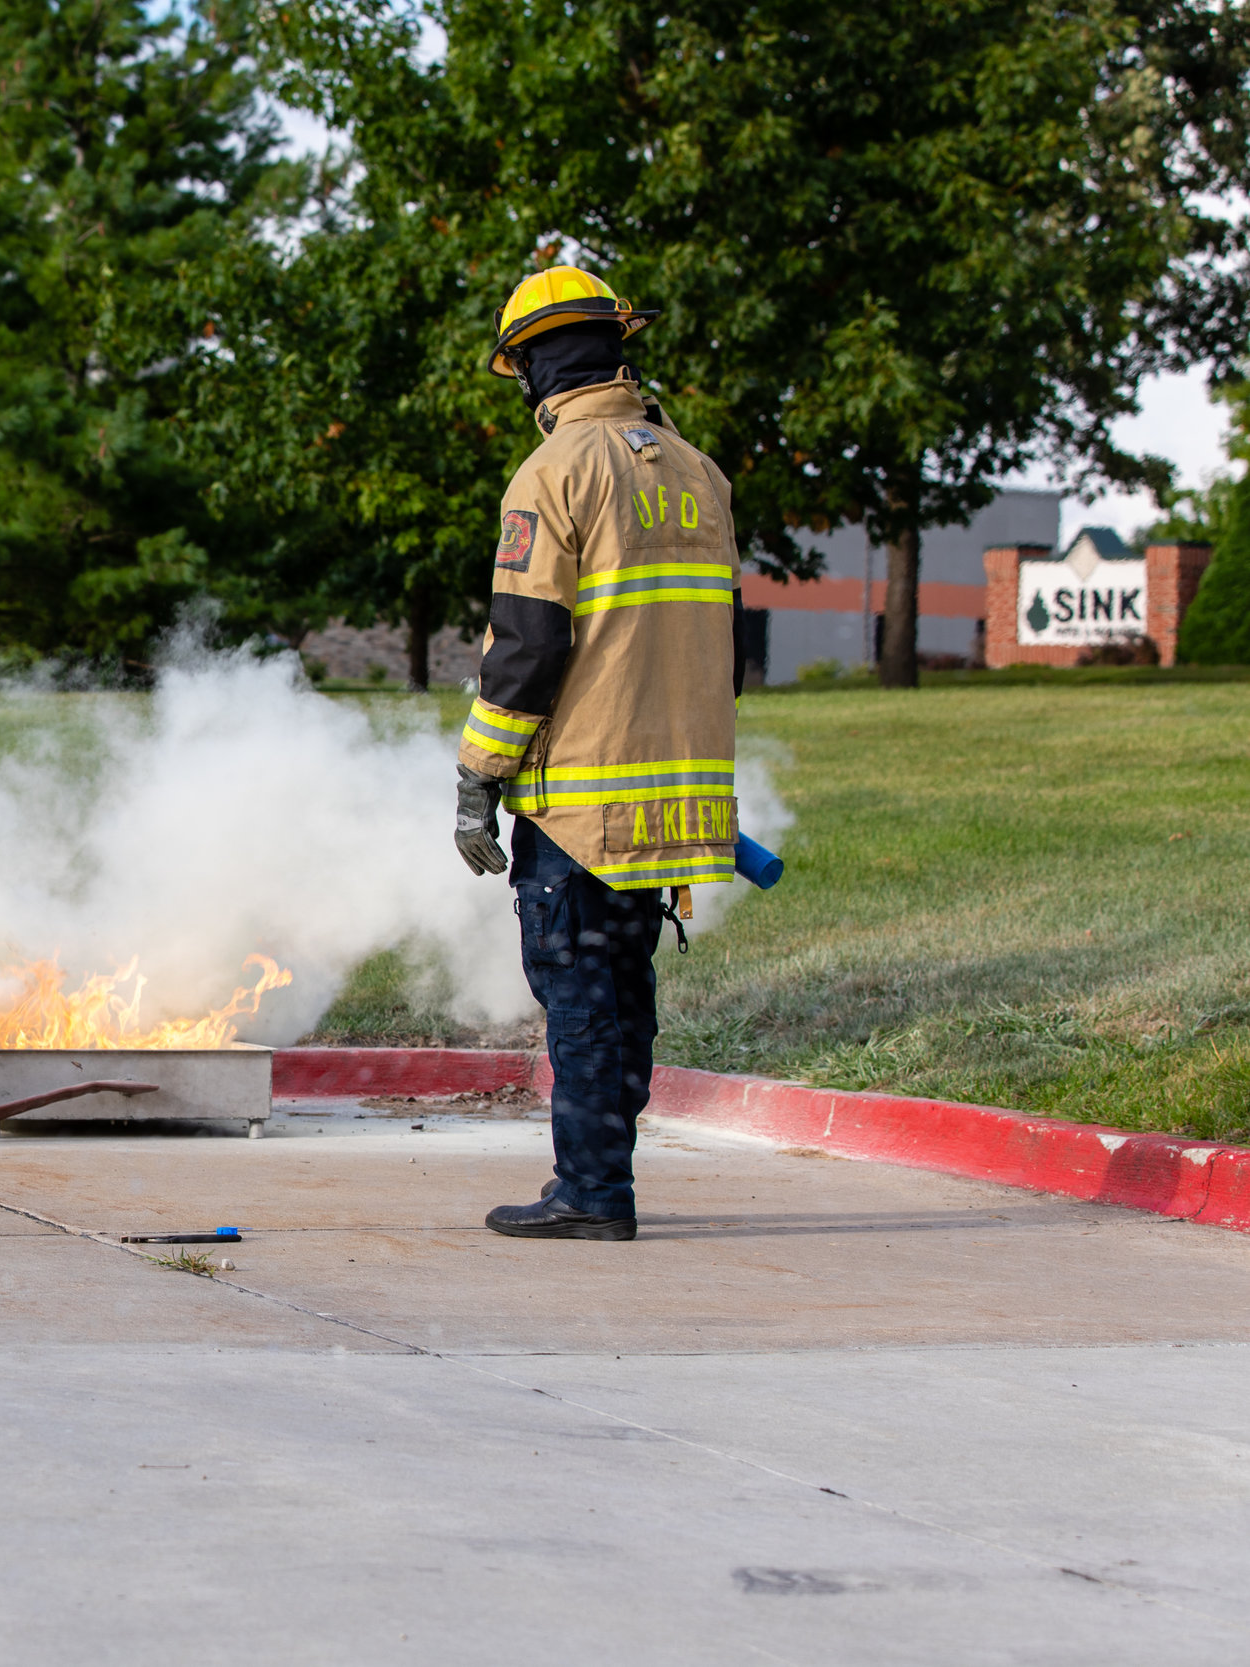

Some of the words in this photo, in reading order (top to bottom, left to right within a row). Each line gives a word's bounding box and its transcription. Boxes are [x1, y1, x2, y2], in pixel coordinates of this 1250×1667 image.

[632, 485, 699, 530] UFD
[1053, 588, 1141, 622] SINK
[632, 805, 656, 846] A.
[663, 800, 732, 842] KLENK
